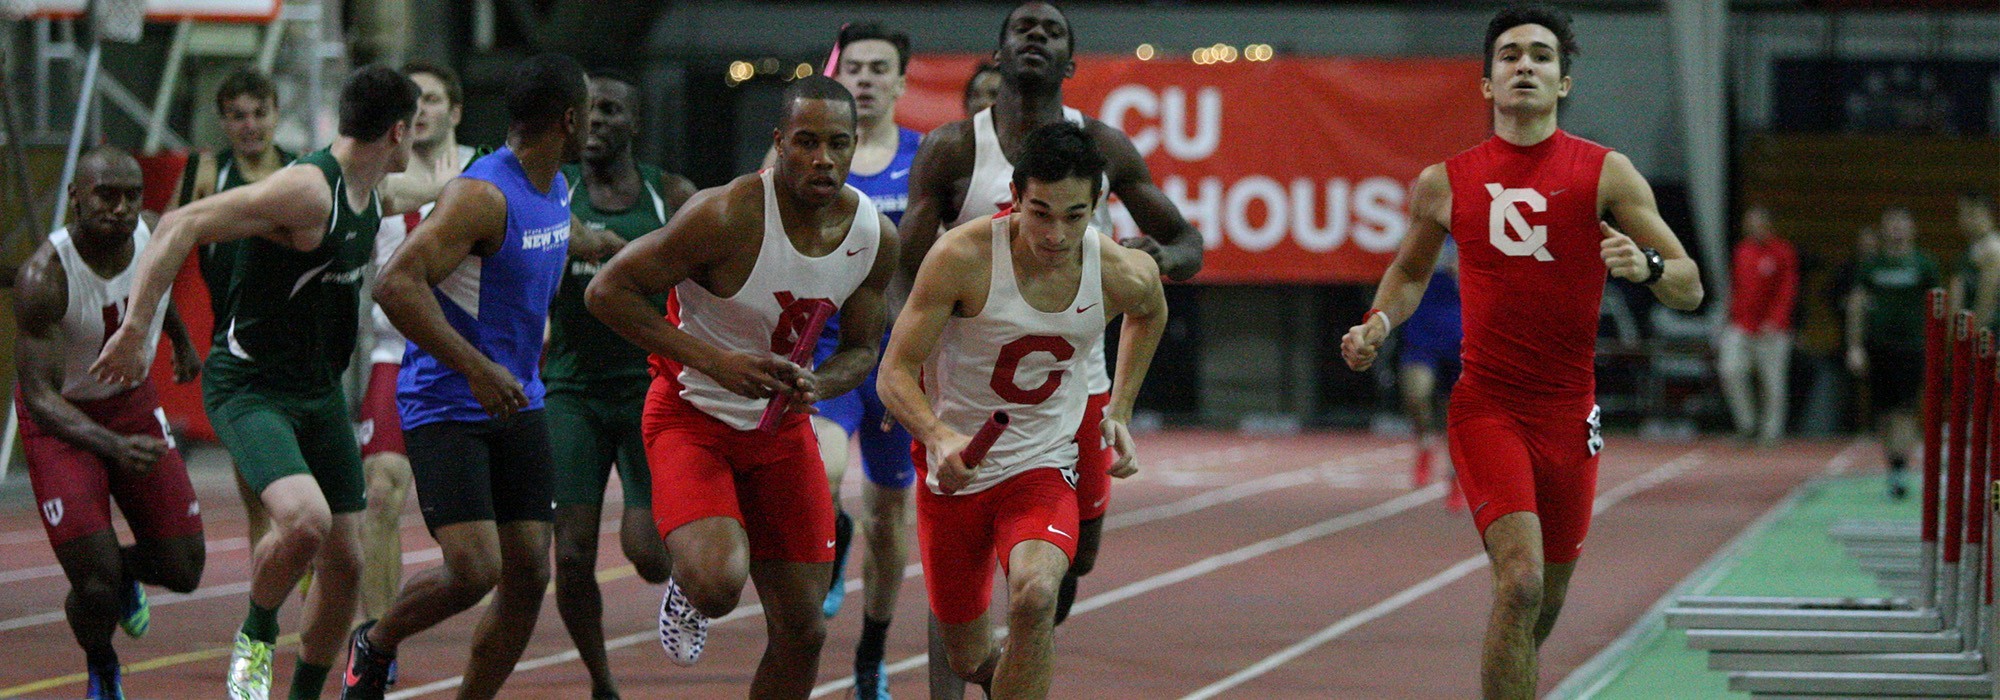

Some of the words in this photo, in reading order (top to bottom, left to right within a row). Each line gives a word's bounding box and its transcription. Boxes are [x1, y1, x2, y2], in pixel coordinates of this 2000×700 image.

[1101, 85, 1223, 161] CU
[522, 231, 552, 250] NEW
[1162, 175, 1412, 252] HOUS
[989, 334, 1076, 405] C
